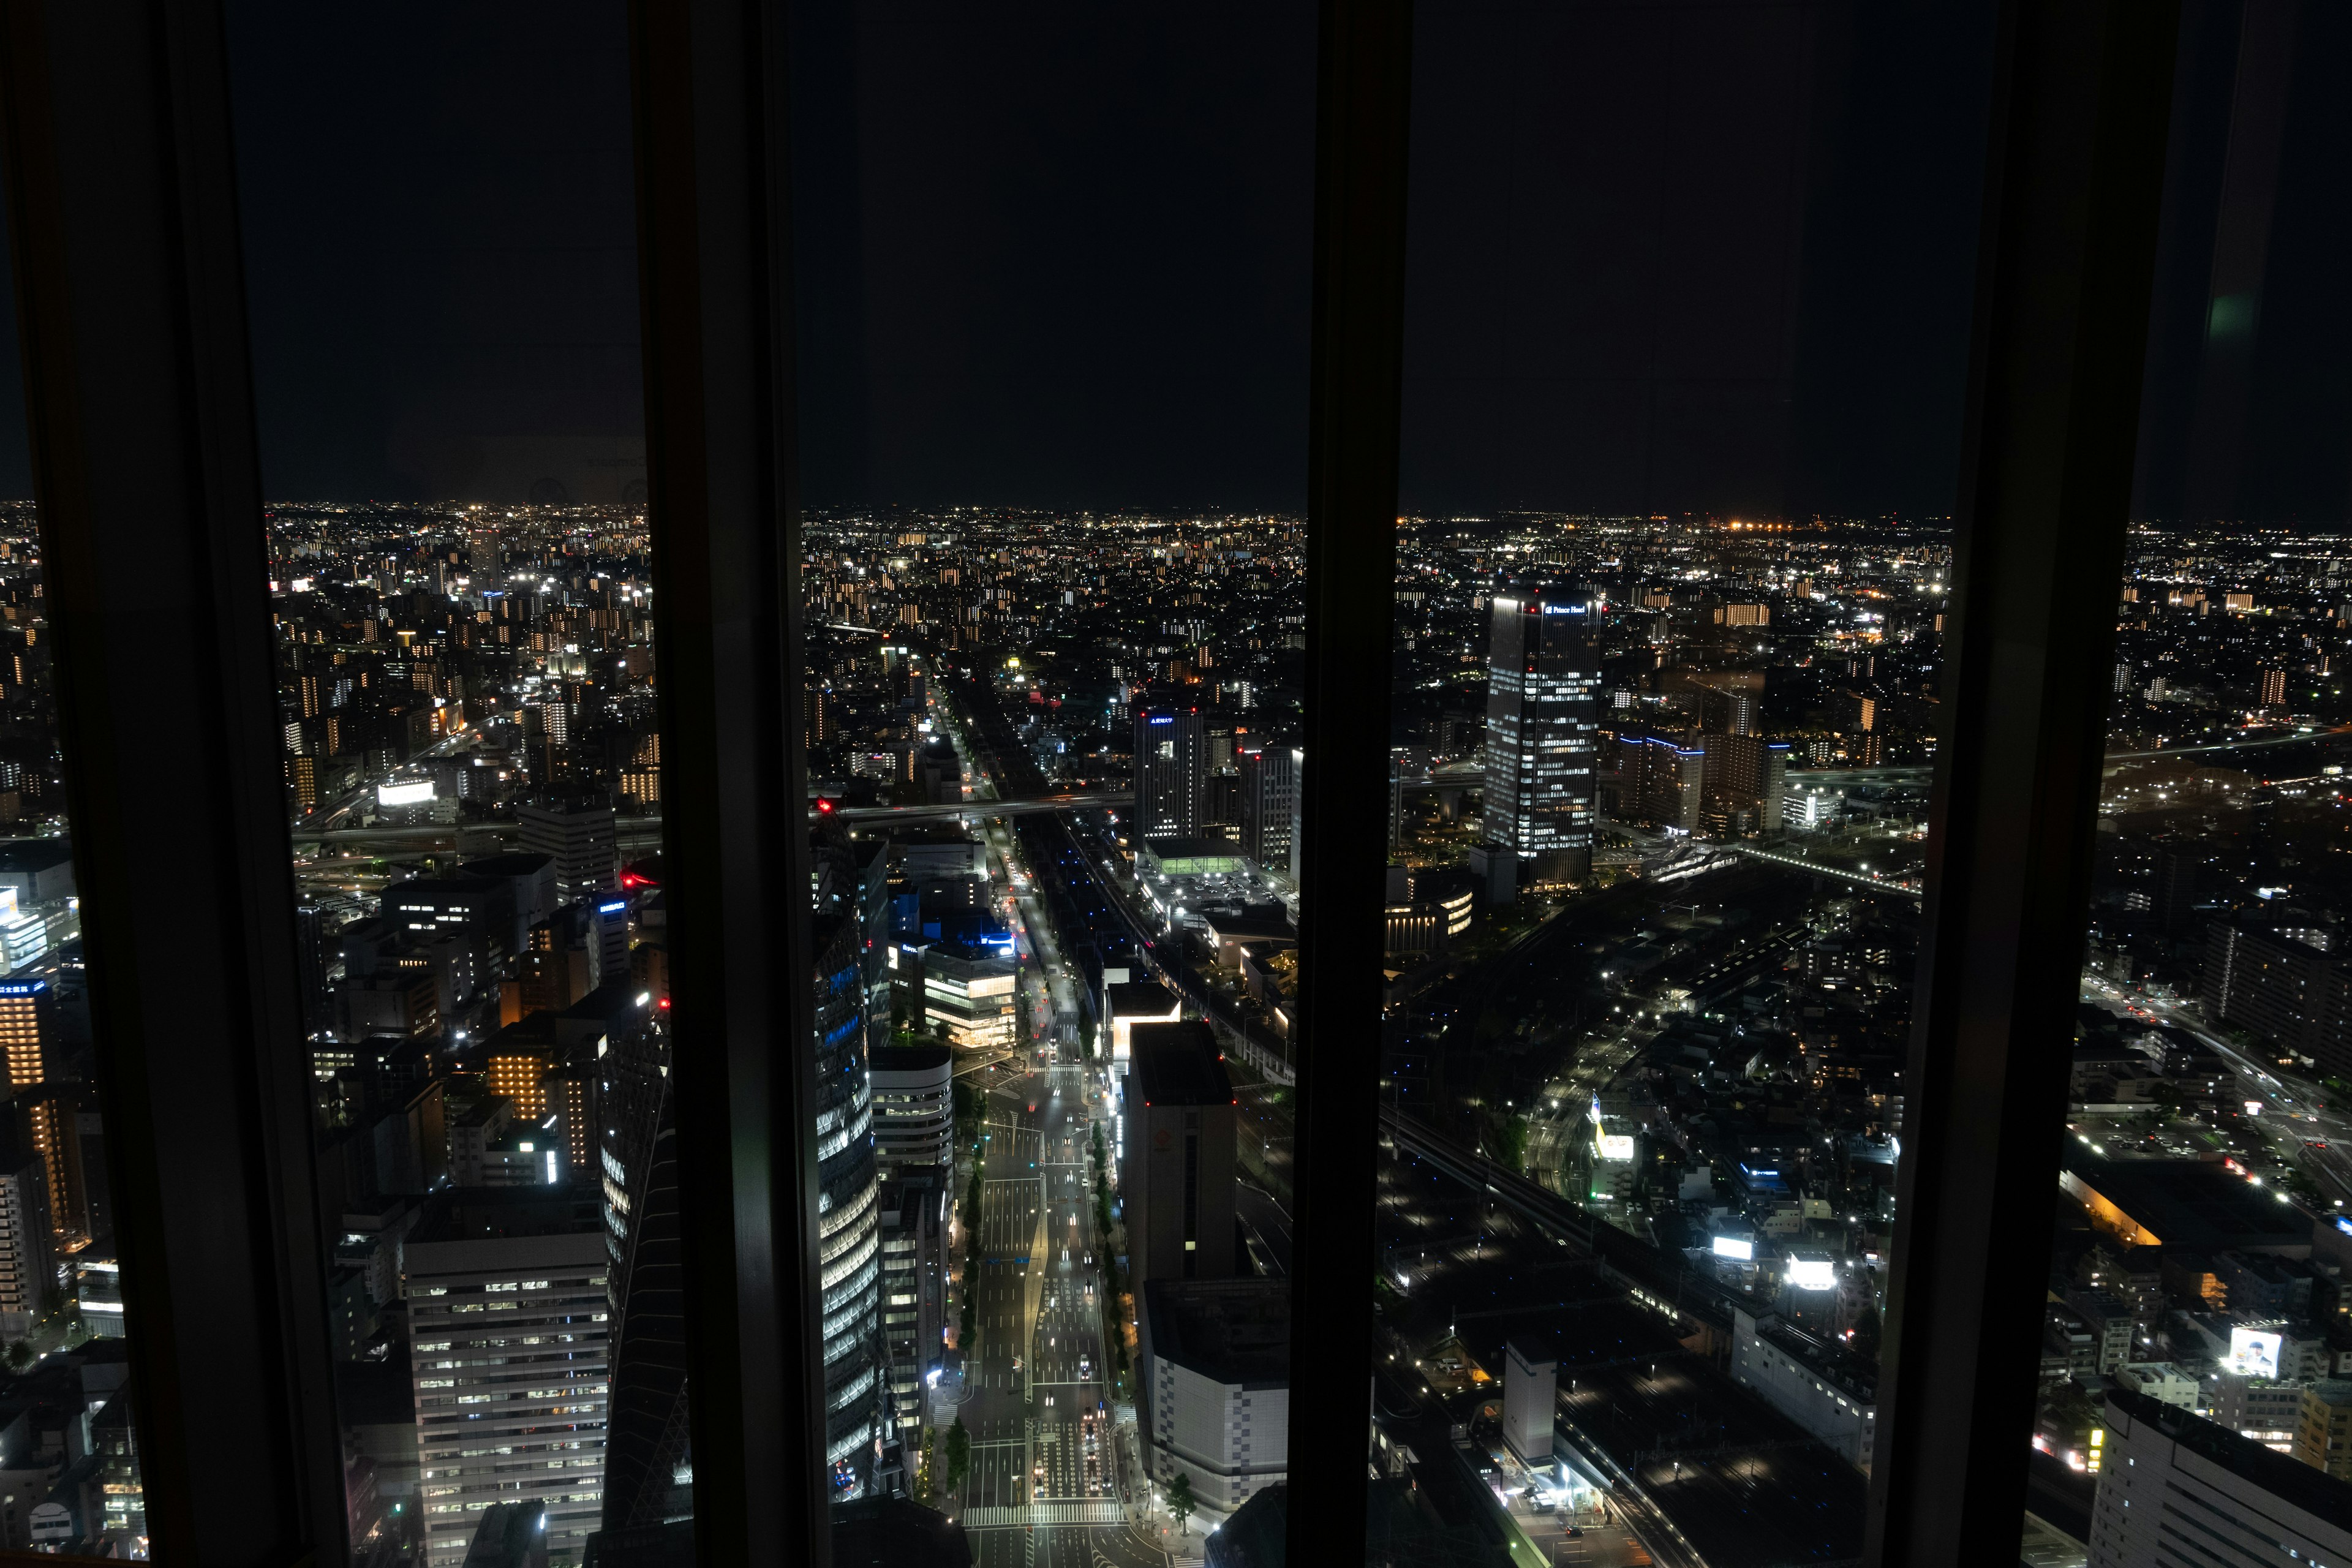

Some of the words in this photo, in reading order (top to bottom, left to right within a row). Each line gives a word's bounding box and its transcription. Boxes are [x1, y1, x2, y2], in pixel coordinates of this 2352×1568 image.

[1052, 1278, 1061, 1313] 名古屋駅方面
[1063, 1278, 1072, 1313] 名古屋駅方面
